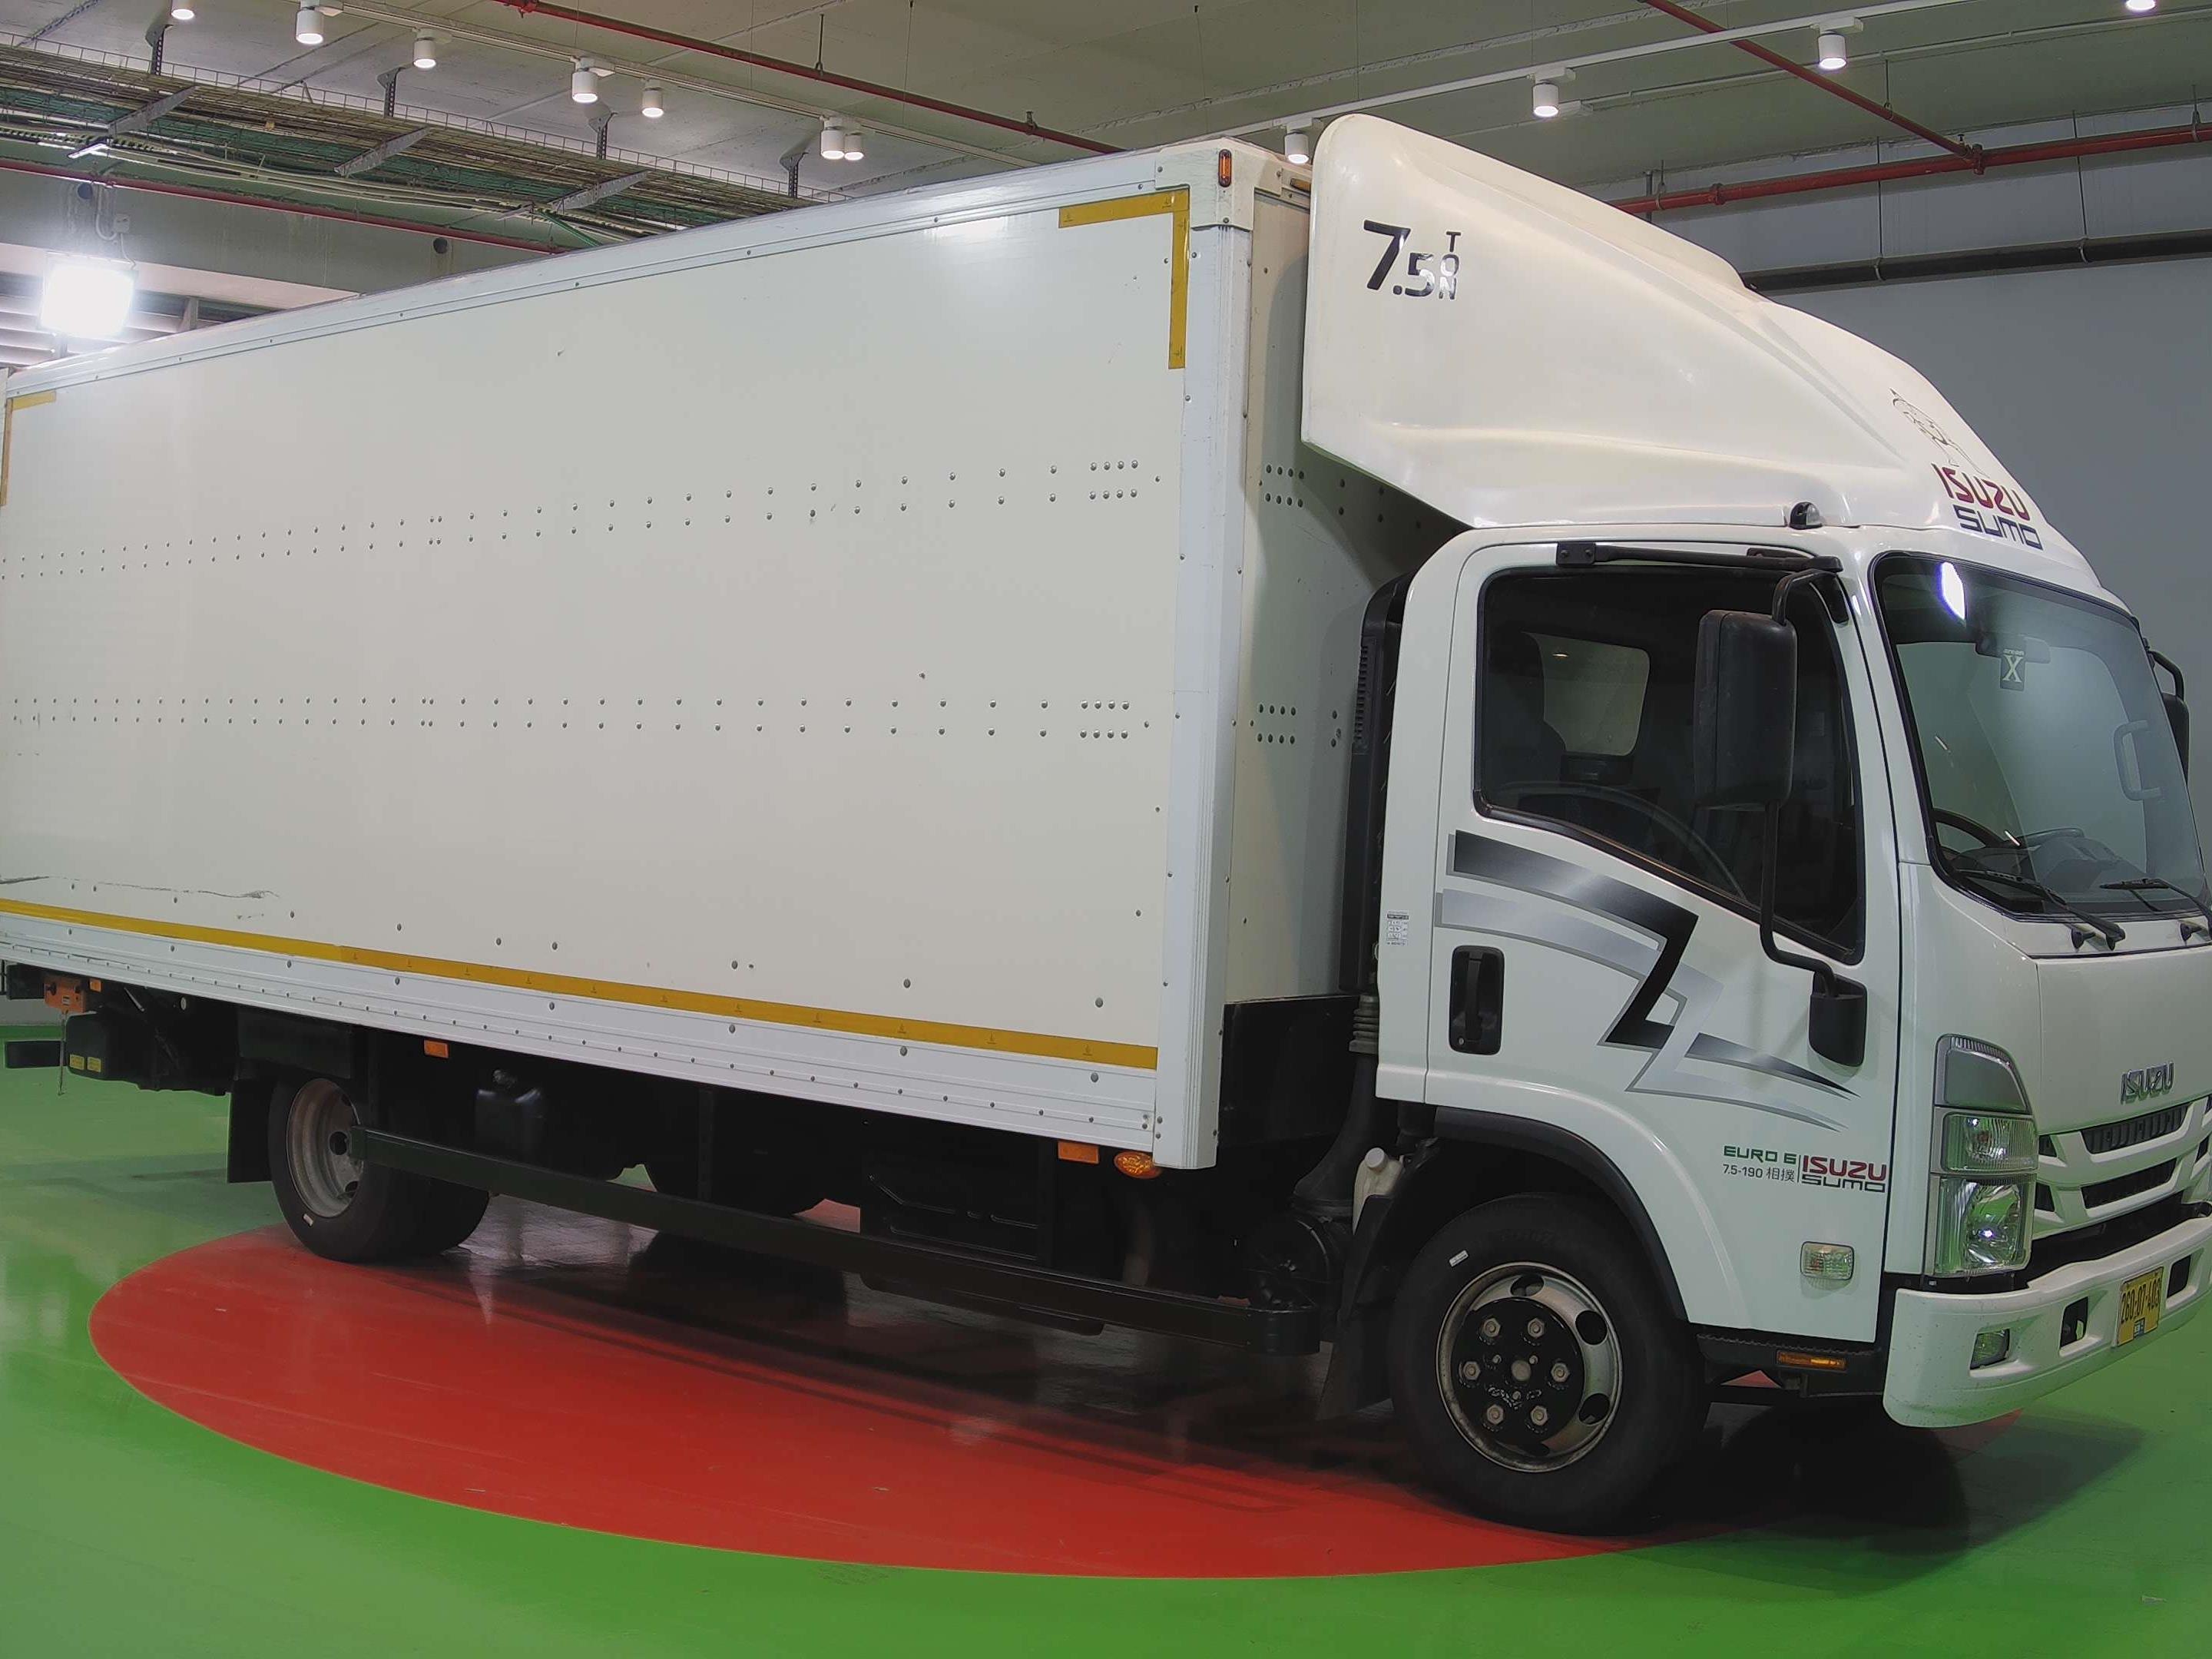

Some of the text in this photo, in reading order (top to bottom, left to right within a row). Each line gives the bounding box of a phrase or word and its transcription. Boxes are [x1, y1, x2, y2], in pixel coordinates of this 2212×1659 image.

[1363, 220, 1435, 296] 7.5
[1931, 462, 2031, 522] ISUZU
[1952, 504, 2045, 551] SUMO
[2002, 654, 2023, 683] X
[2120, 1061, 2175, 1104] ISUZU
[1724, 1145, 1797, 1164] EURO 6
[1802, 1155, 1887, 1181] ISUZU
[1722, 1164, 1763, 1179] 7.5-190
[1801, 1174, 1886, 1193] SUMO
